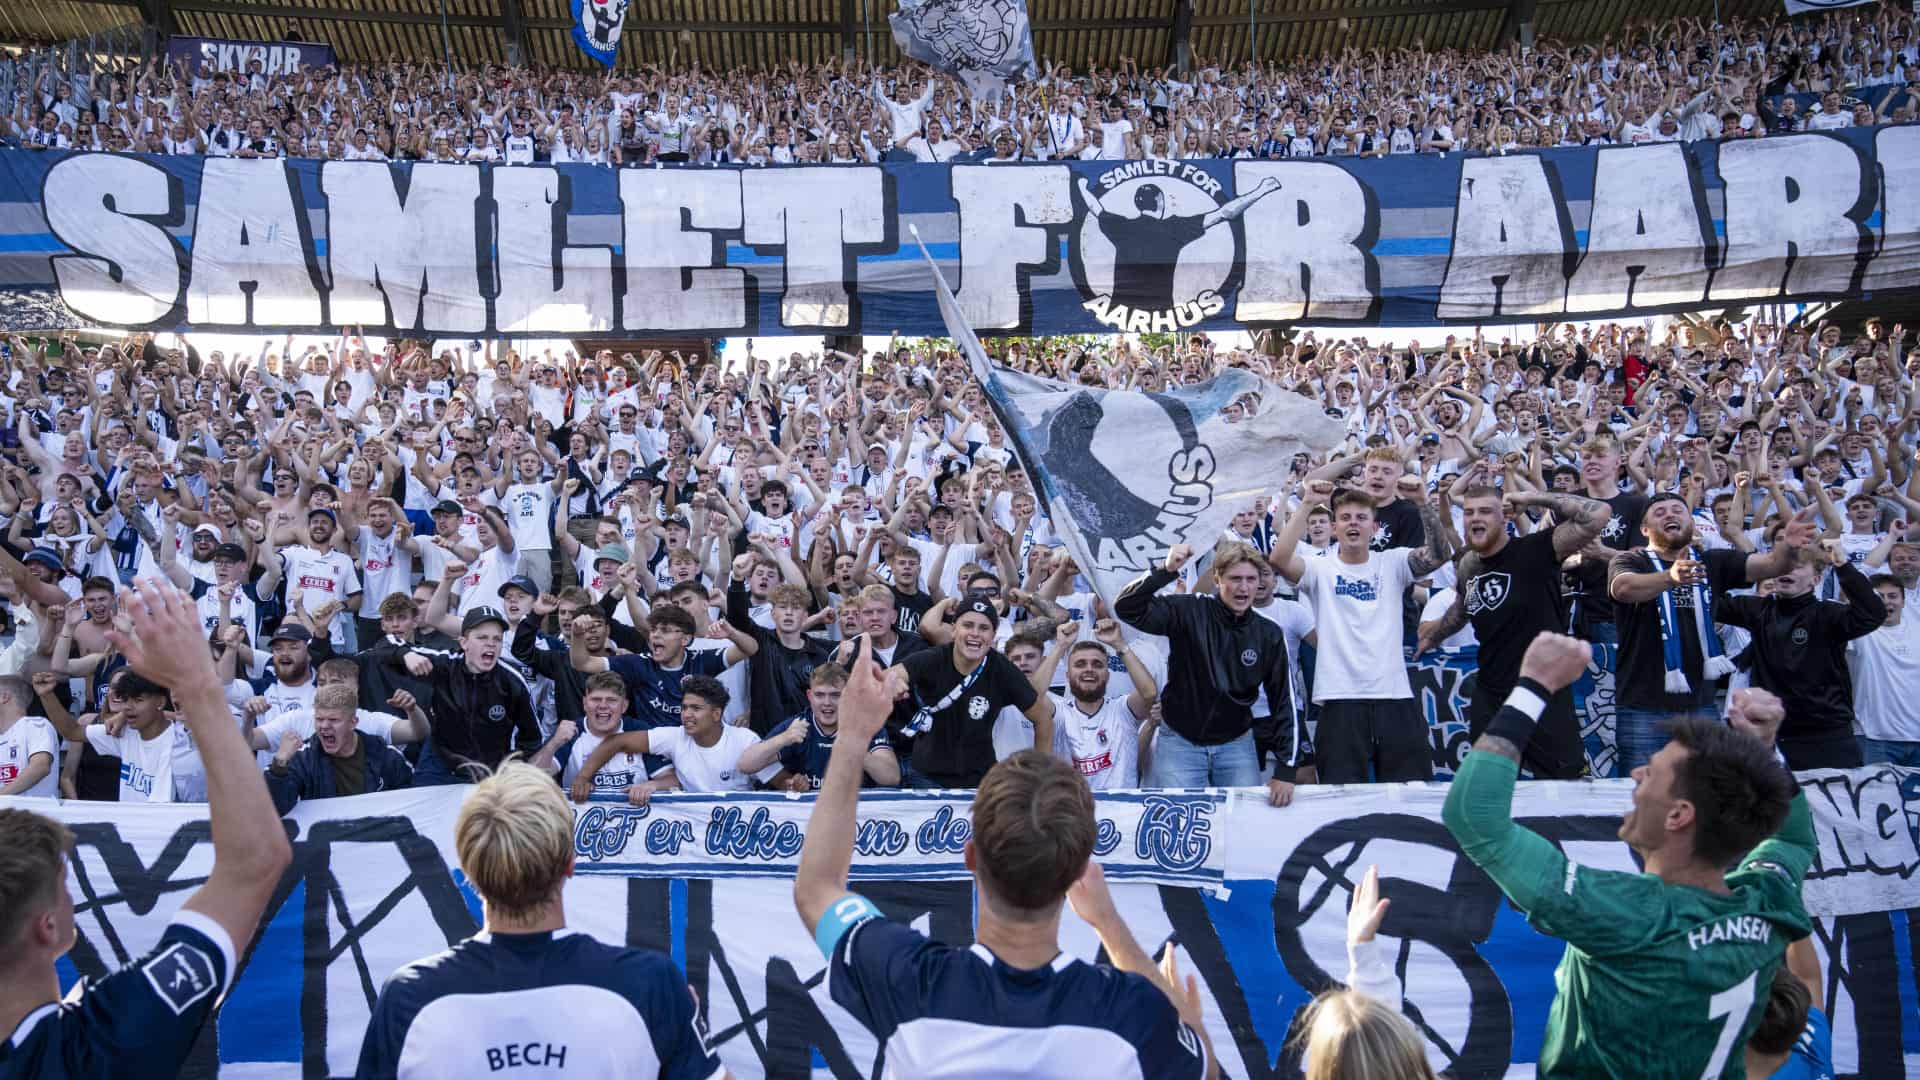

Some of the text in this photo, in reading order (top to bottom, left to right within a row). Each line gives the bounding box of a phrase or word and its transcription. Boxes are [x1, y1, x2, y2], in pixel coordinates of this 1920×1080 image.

[200, 42, 301, 76] SKYBAR
[1099, 160, 1222, 197] SAMLET FOR
[42, 153, 886, 335] SAMLET
[1082, 290, 1225, 334] AARHUS
[573, 804, 650, 861] GF
[645, 818, 695, 855] er
[705, 806, 804, 860] ikke
[1687, 915, 1773, 950] HANSEN
[486, 1042, 567, 1072] BECH
